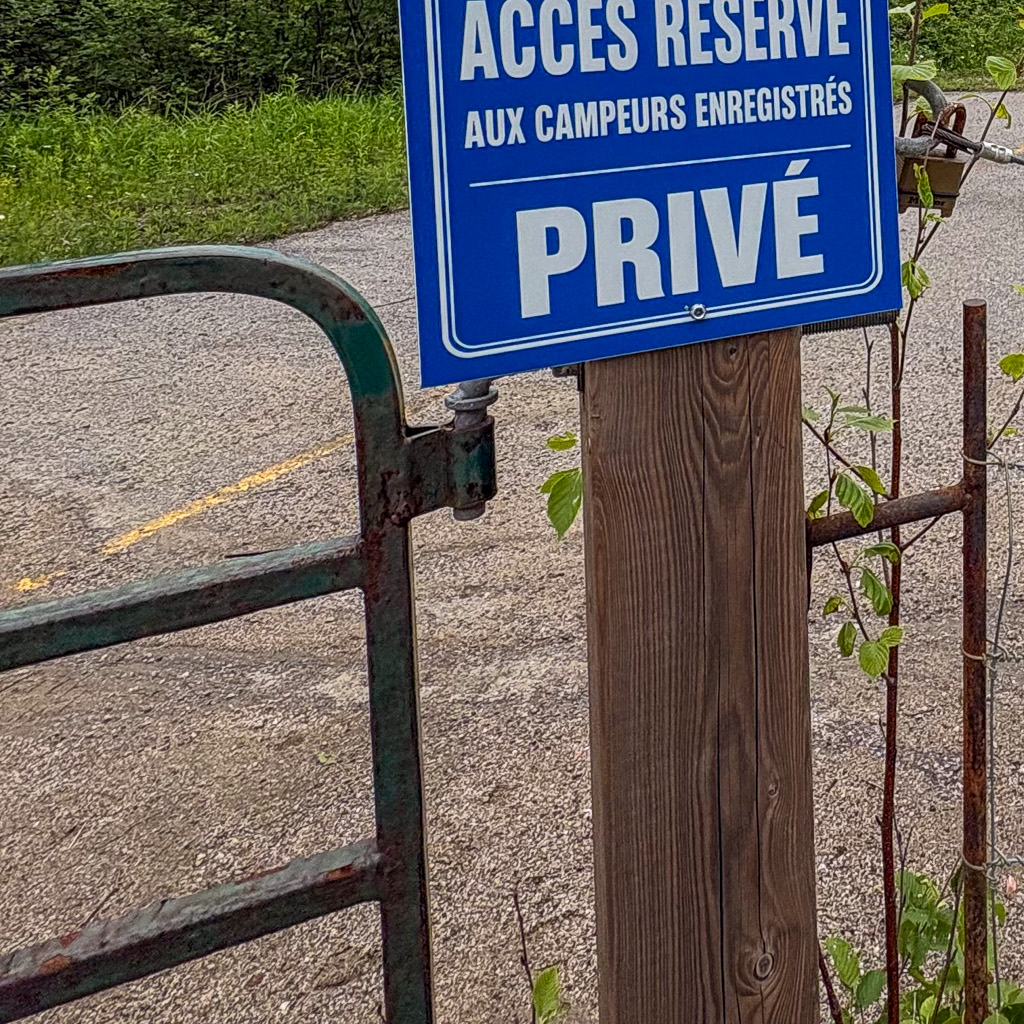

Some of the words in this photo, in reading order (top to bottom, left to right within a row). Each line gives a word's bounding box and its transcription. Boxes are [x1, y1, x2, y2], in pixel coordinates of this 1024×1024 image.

[464, 107, 527, 149] AUX
[535, 93, 687, 142] CAMPEURS
[695, 76, 853, 128] ENREGISTRÉS
[515, 158, 825, 319] PRIVÉ
